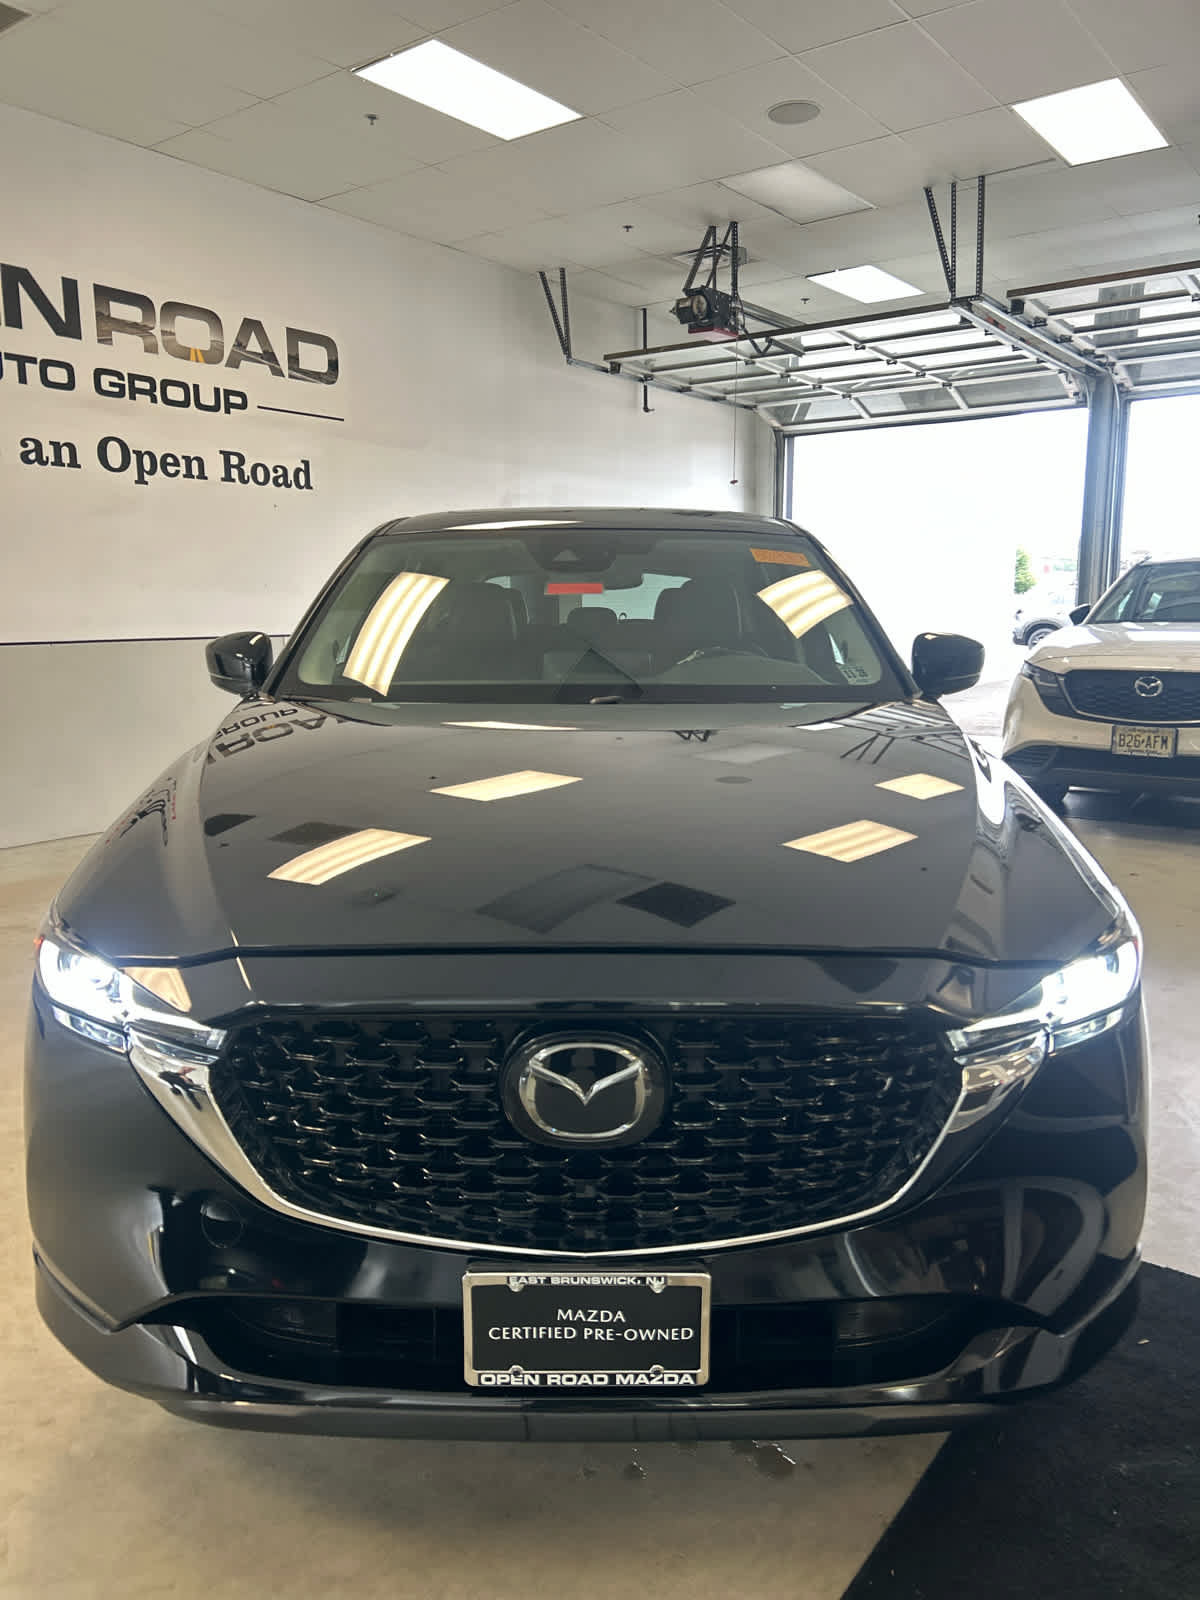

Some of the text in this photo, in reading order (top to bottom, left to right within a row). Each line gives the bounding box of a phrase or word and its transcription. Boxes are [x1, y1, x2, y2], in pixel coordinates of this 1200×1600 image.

[93, 282, 339, 386] ROAD
[93, 367, 248, 415] GROUP
[19, 435, 313, 490] an Open Road
[509, 1276, 547, 1285] EAST
[645, 1276, 665, 1285] NJ
[556, 1309, 626, 1323] MAZDA
[488, 1327, 694, 1341] CERTIFIED PRE-OWNED
[480, 1373, 695, 1386] OPEN ROAD MAZDA
